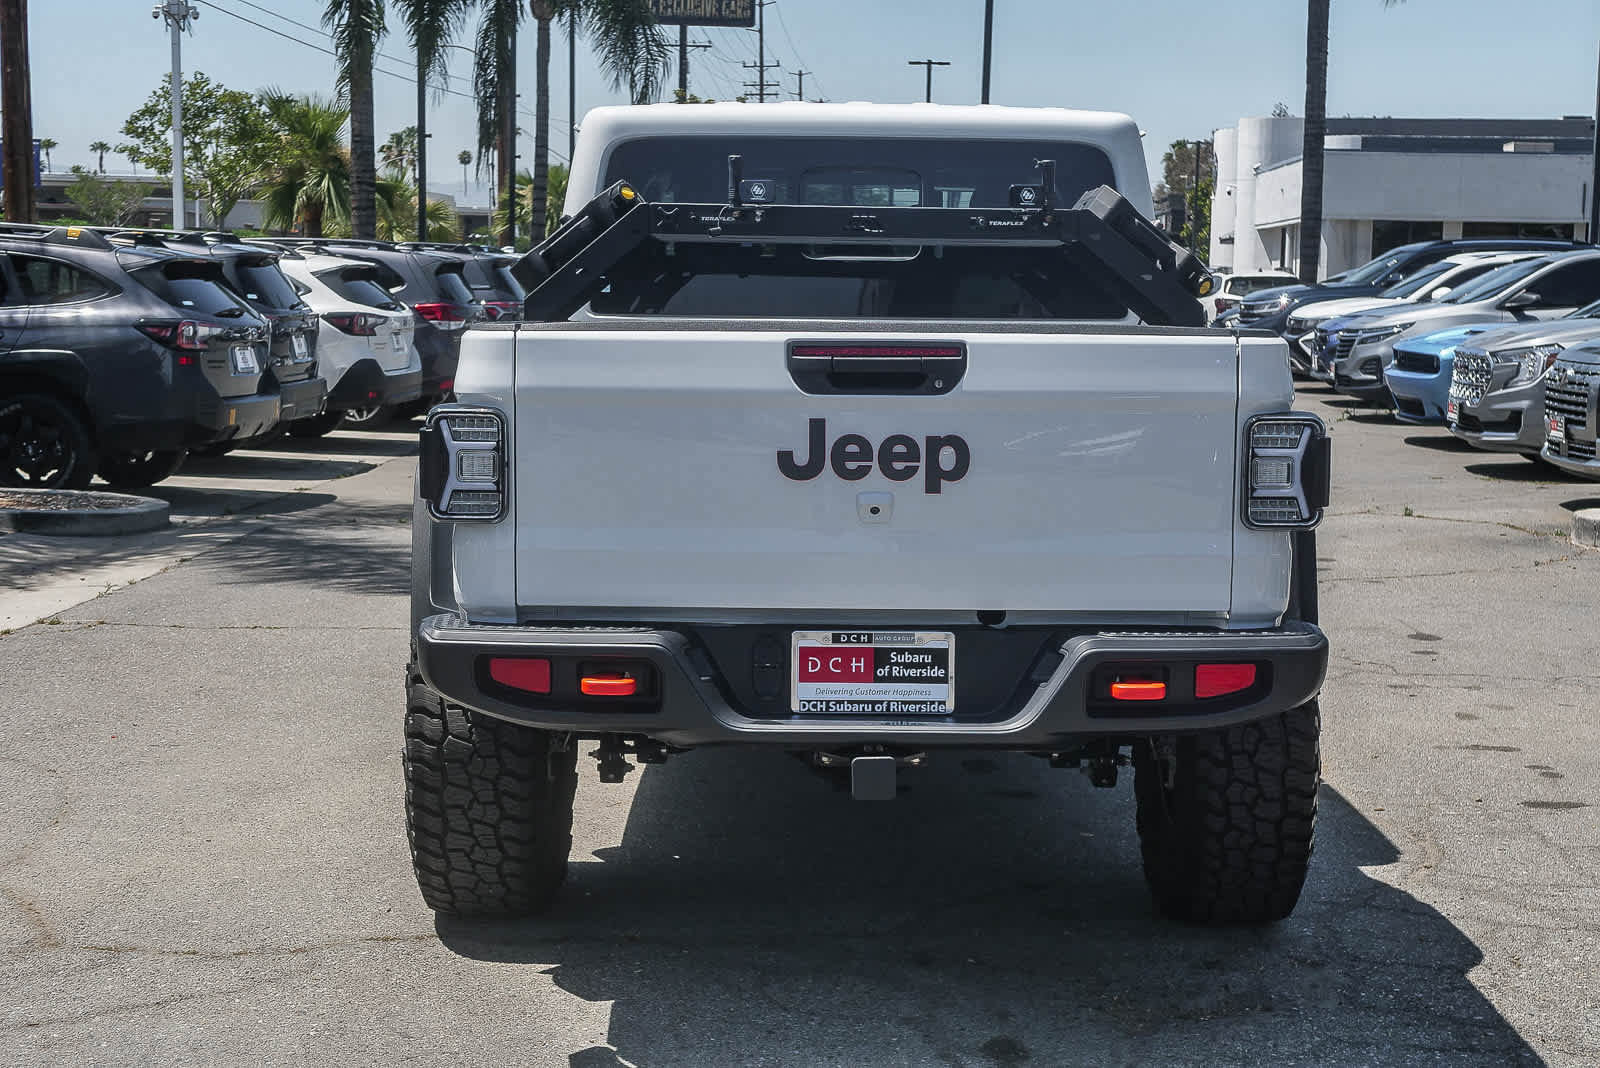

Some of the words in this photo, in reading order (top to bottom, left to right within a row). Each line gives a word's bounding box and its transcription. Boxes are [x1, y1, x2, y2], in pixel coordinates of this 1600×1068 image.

[722, 0, 751, 17] CARS
[776, 417, 971, 495] Jeep
[890, 651, 932, 663] Subaru
[876, 665, 890, 677] of
[892, 666, 945, 677] Riverside
[815, 687, 853, 696] Delivering
[855, 687, 890, 696] Customer
[893, 688, 932, 697] Happiness
[800, 701, 826, 712] DCH
[828, 701, 872, 712] Subaru
[875, 701, 887, 712] of
[890, 701, 945, 712] Riverside
